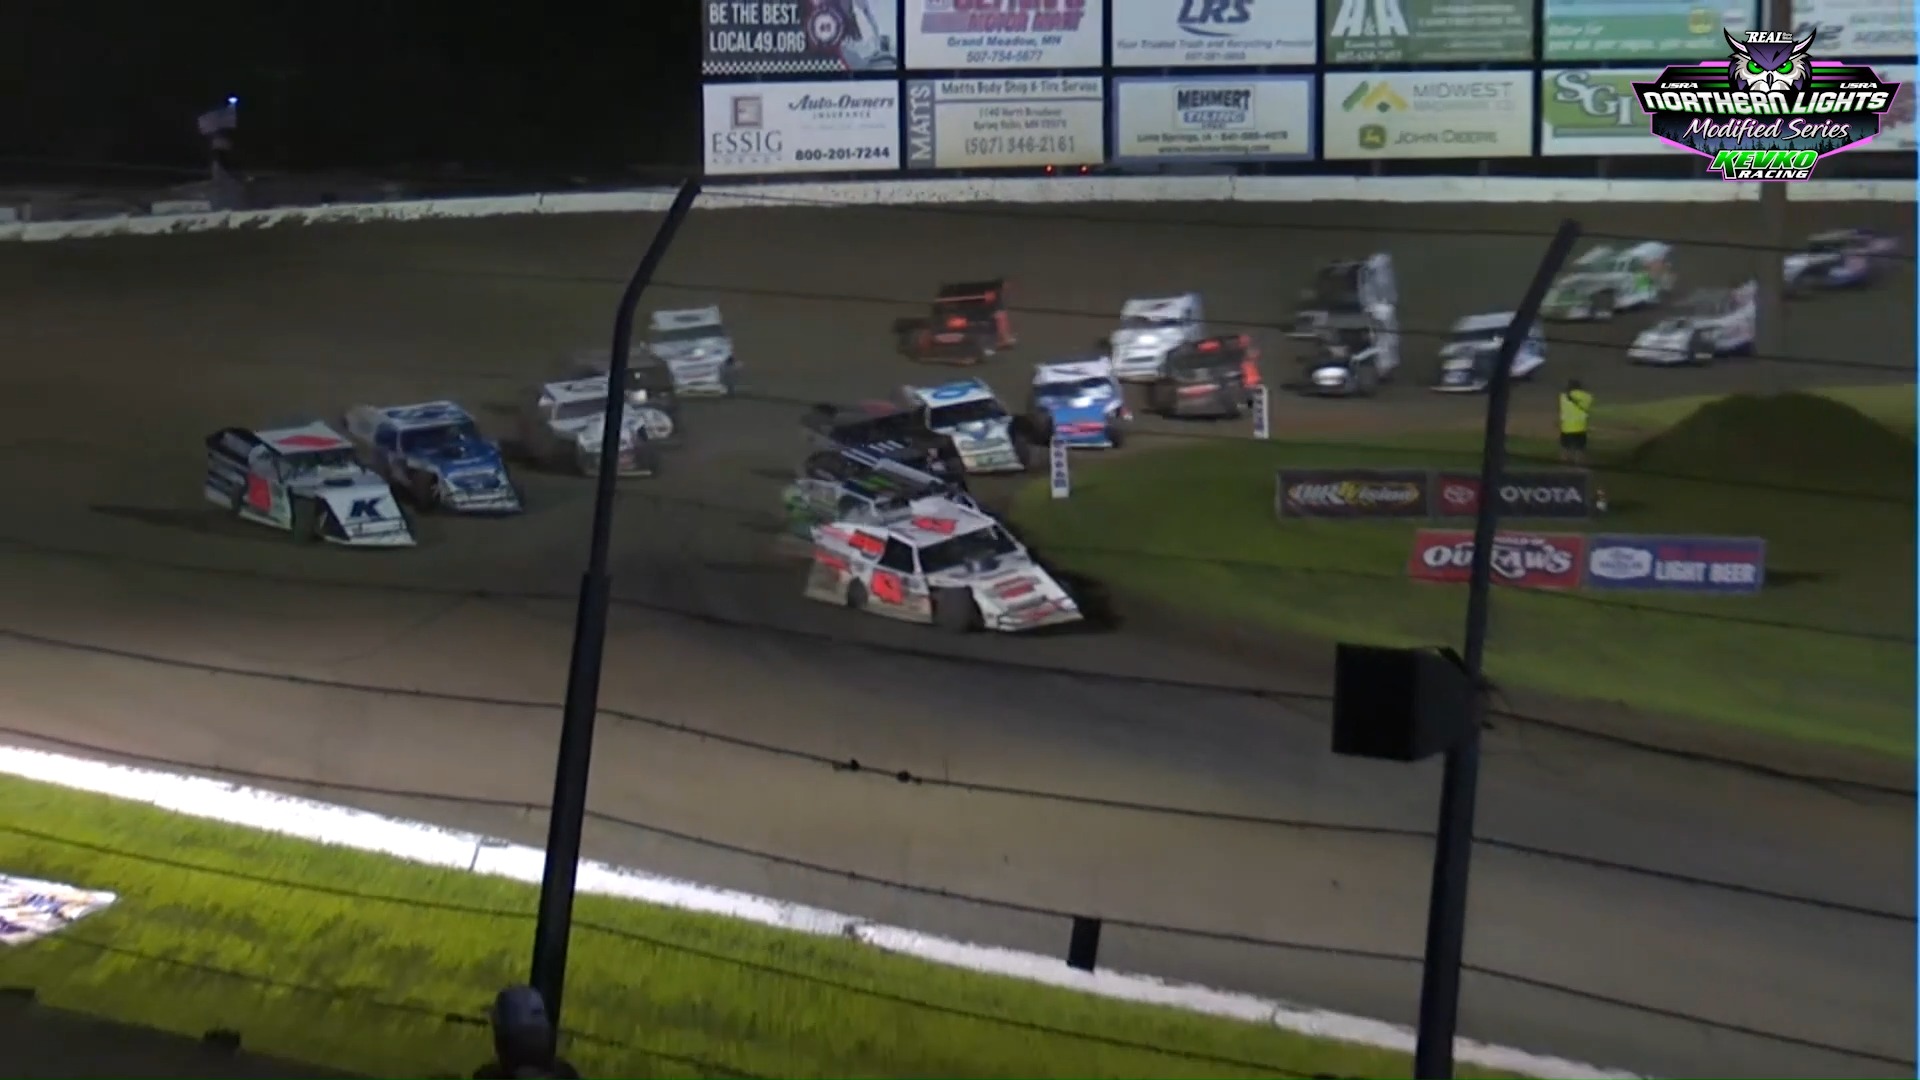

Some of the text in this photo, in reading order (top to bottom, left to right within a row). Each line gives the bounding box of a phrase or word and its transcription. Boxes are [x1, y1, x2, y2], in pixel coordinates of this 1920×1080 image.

[709, 2, 800, 25] BE THE BEST.
[709, 30, 806, 53] LOCAL49.ORG
[947, 36, 983, 47] Grand
[1041, 35, 1062, 46] MN
[1413, 82, 1514, 98] MIDWEST
[788, 93, 895, 111] Auto-Owners
[1177, 89, 1250, 111] MEHMERT
[910, 85, 931, 160] MATTS
[712, 132, 782, 153] ESSIG
[965, 137, 1003, 155] (507)
[1395, 130, 1498, 145] JOHN DEERE
[795, 147, 890, 161] 800-201-7244
[1500, 485, 1582, 503] OYOTA
[1655, 560, 1706, 581] LIGHT
[1709, 563, 1755, 583] BEER
